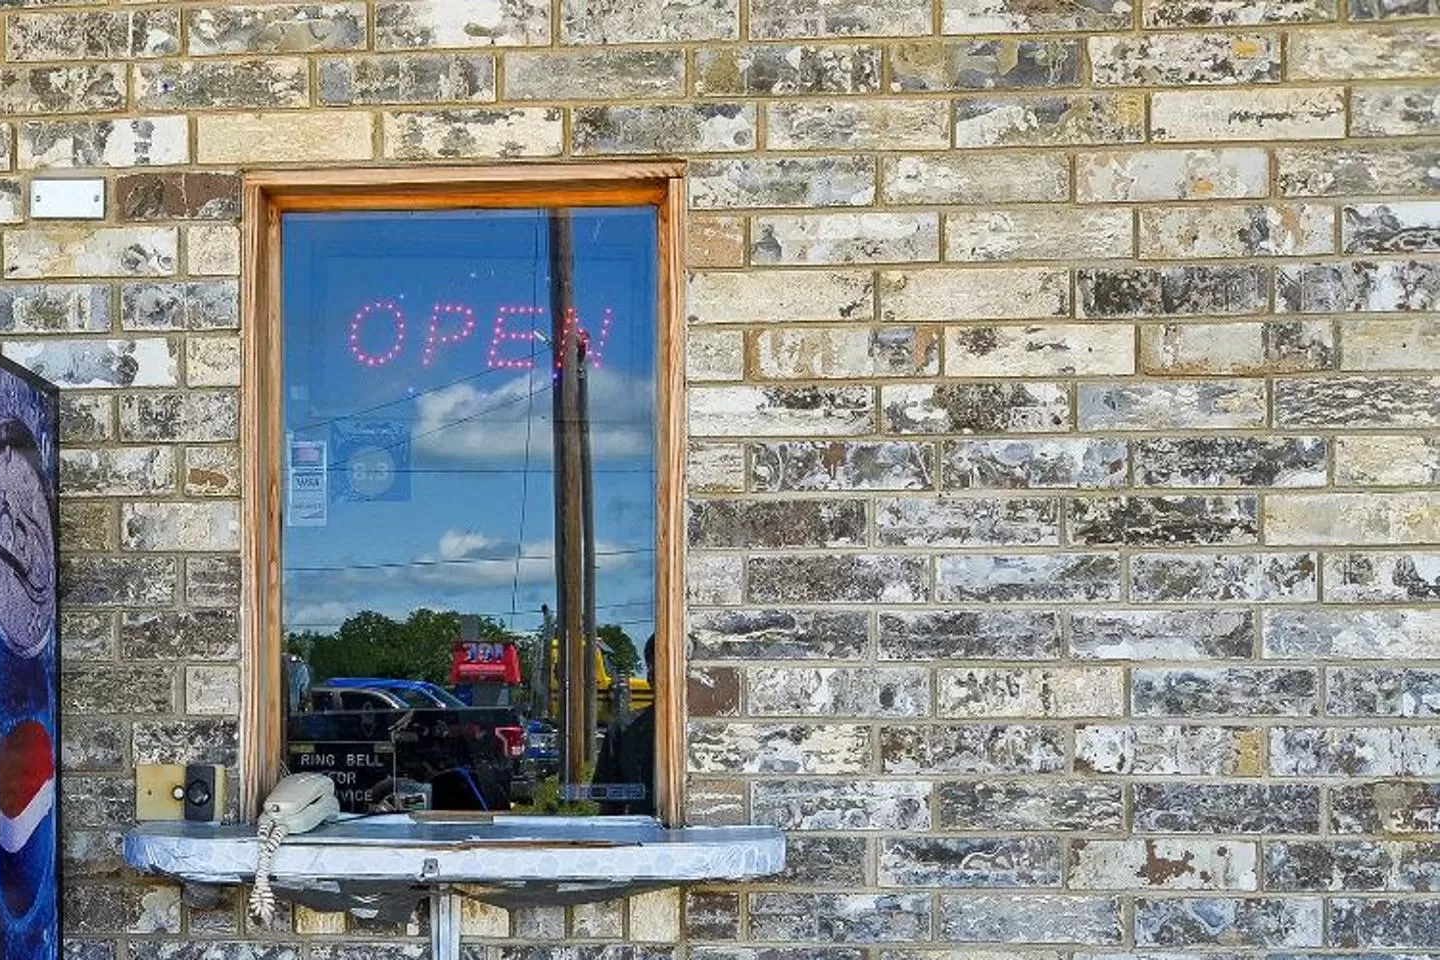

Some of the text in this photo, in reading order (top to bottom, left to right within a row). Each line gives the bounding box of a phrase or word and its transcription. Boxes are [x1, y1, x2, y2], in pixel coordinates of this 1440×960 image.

[350, 300, 614, 368] OPEN
[300, 753, 384, 768] RING BELL
[335, 789, 374, 802] VICE
